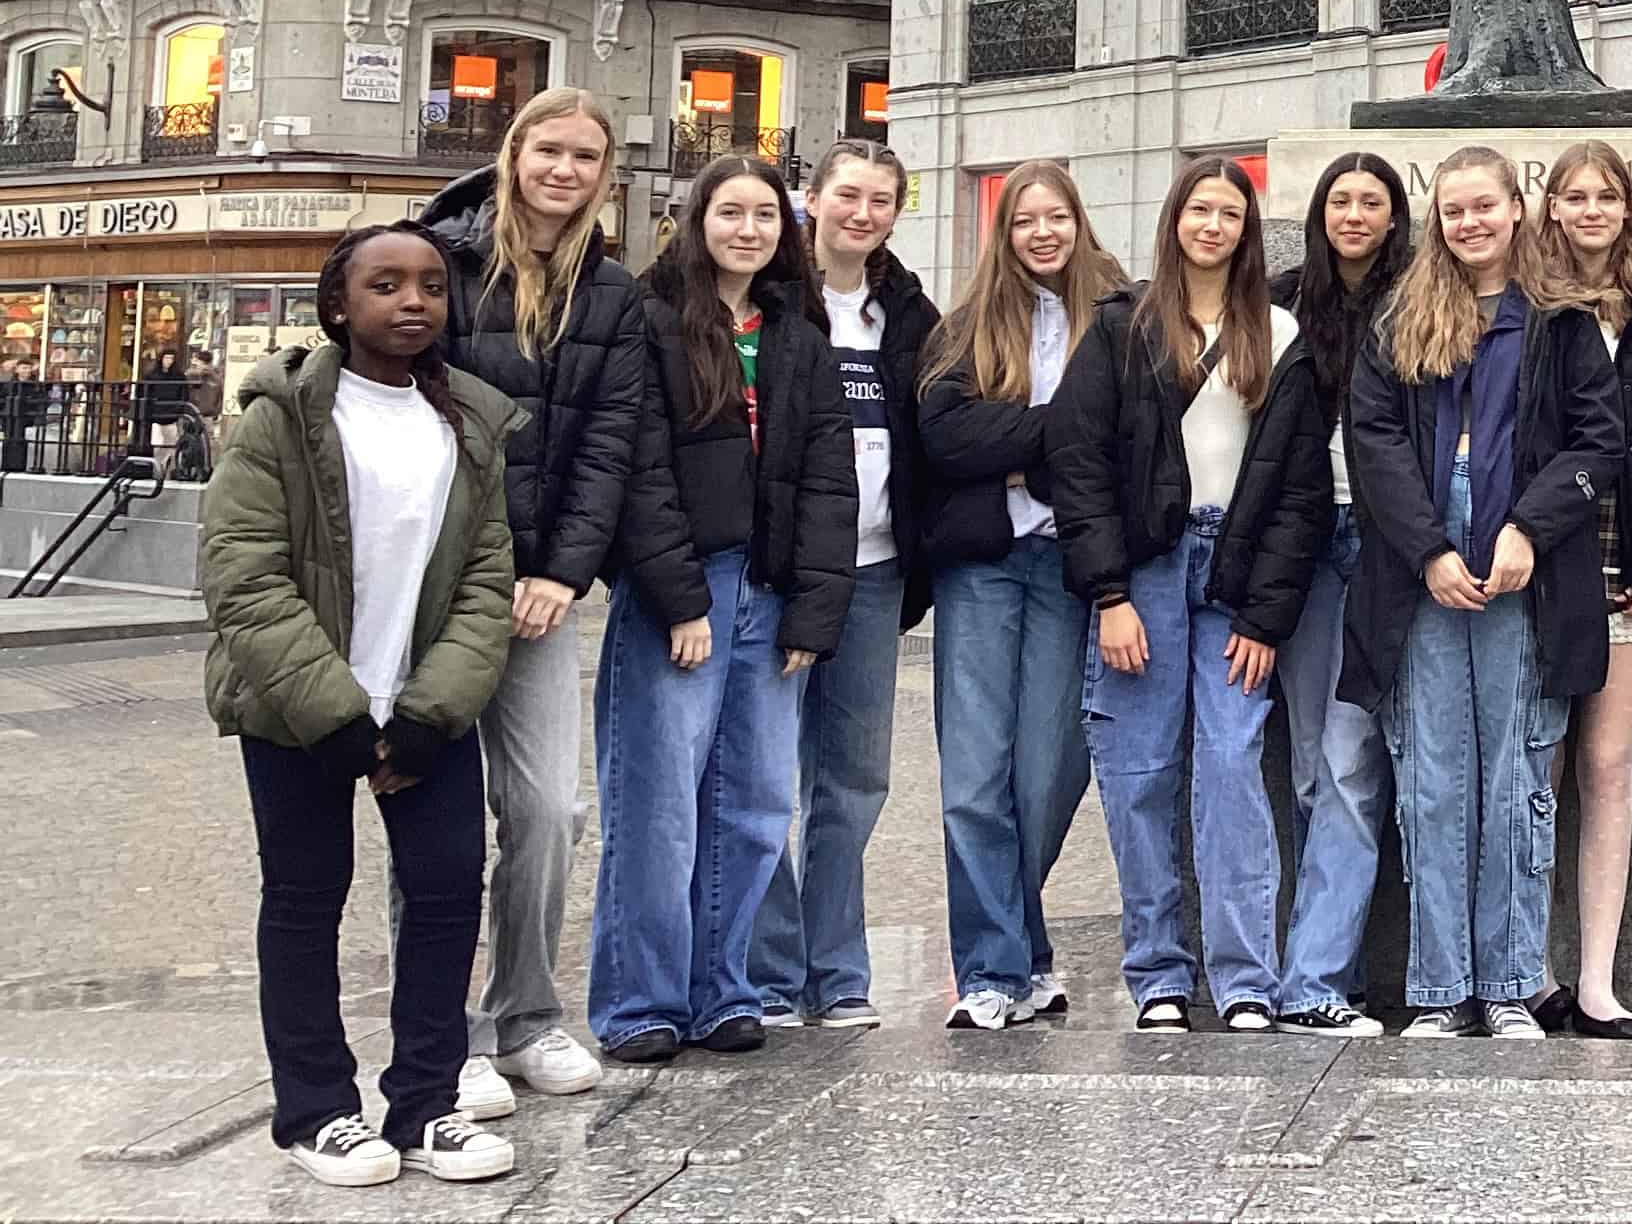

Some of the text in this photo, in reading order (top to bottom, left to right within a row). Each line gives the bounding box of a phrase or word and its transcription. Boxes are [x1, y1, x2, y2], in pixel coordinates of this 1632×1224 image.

[346, 87, 397, 100] MONTERA
[58, 203, 88, 236] DE
[101, 199, 177, 233] DIEGO
